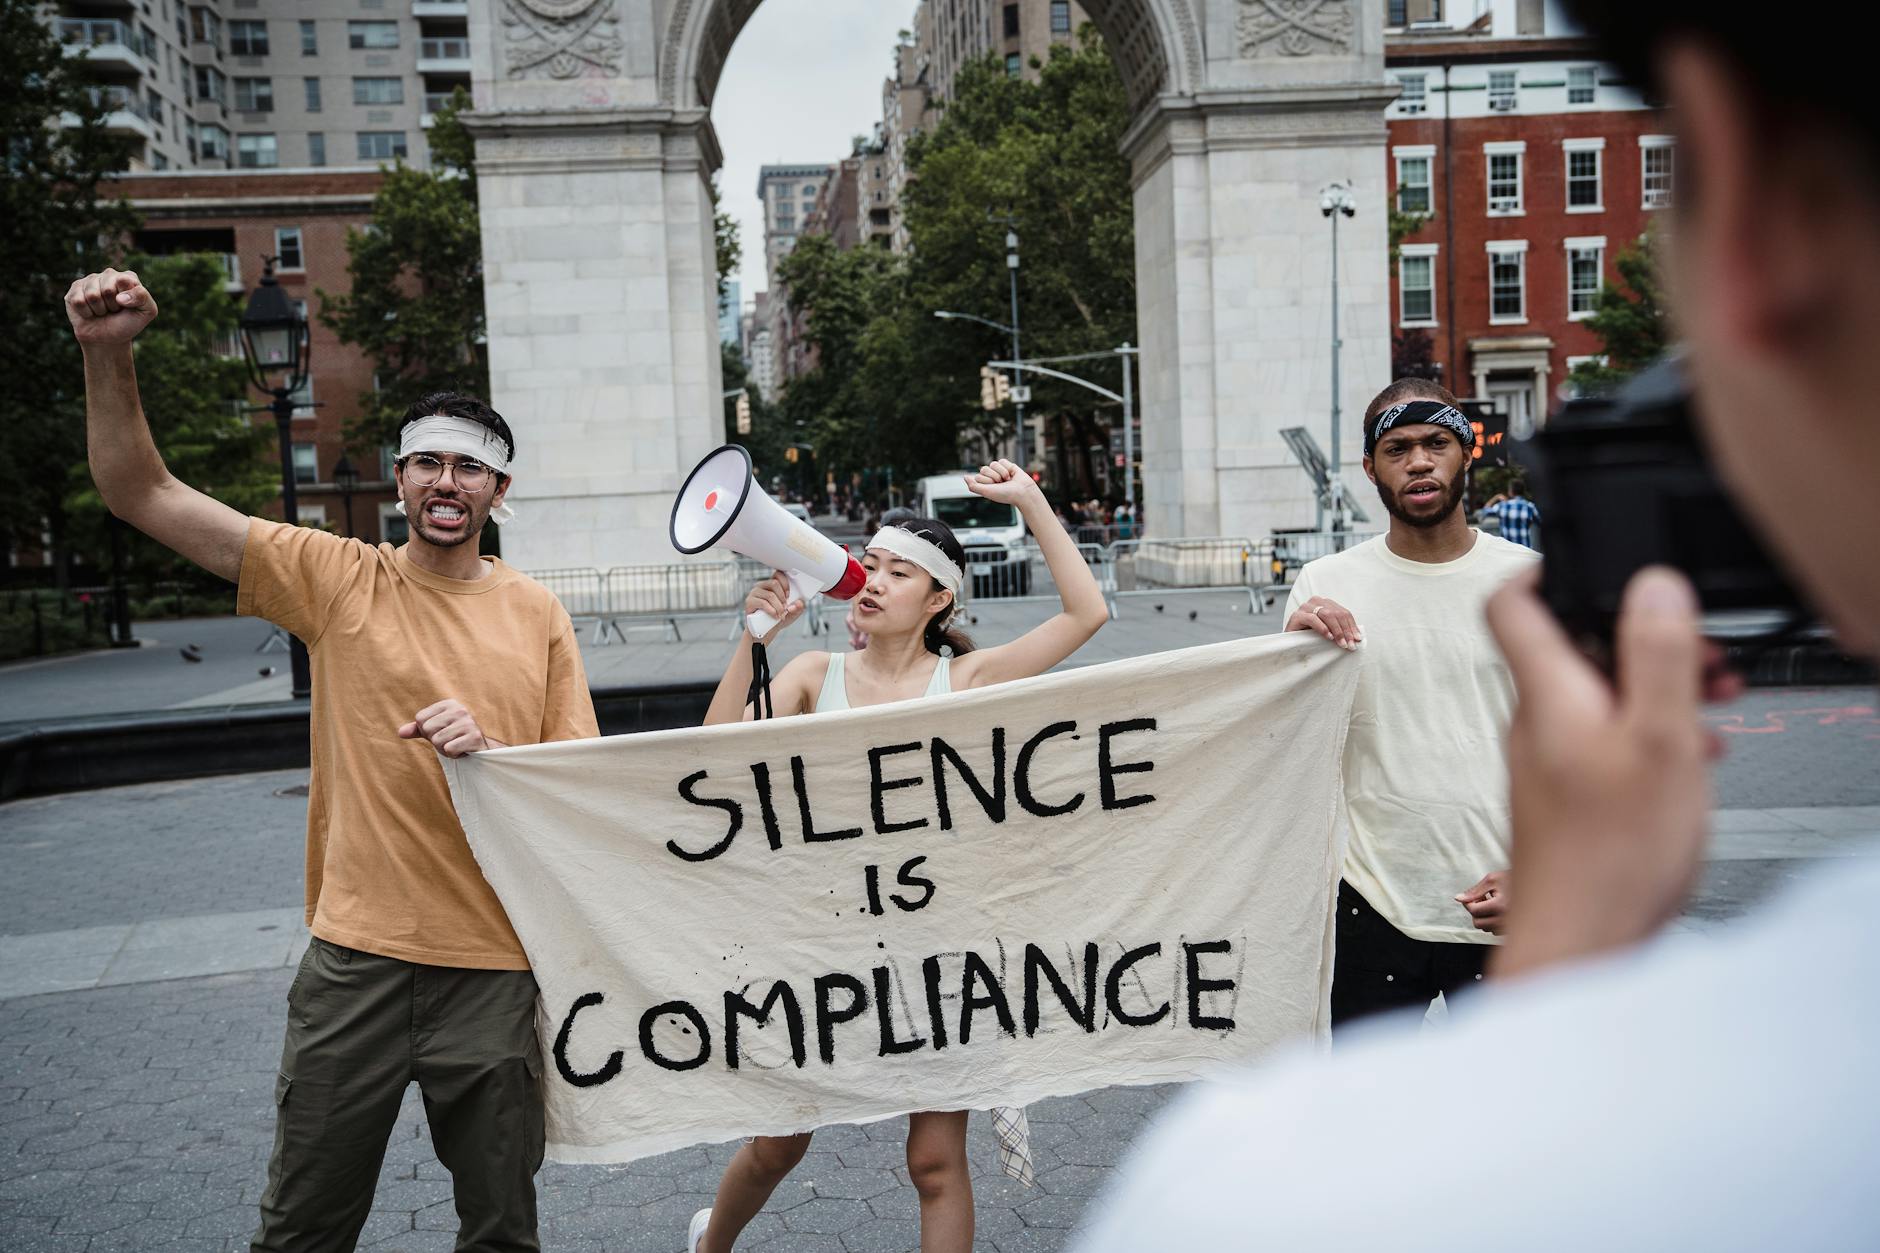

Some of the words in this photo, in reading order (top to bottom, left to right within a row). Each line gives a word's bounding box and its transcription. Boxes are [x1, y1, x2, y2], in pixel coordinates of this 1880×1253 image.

[666, 718, 1157, 863] SILENCE
[864, 855, 937, 917] IS
[552, 939, 1236, 1088] COMPLIANCE
